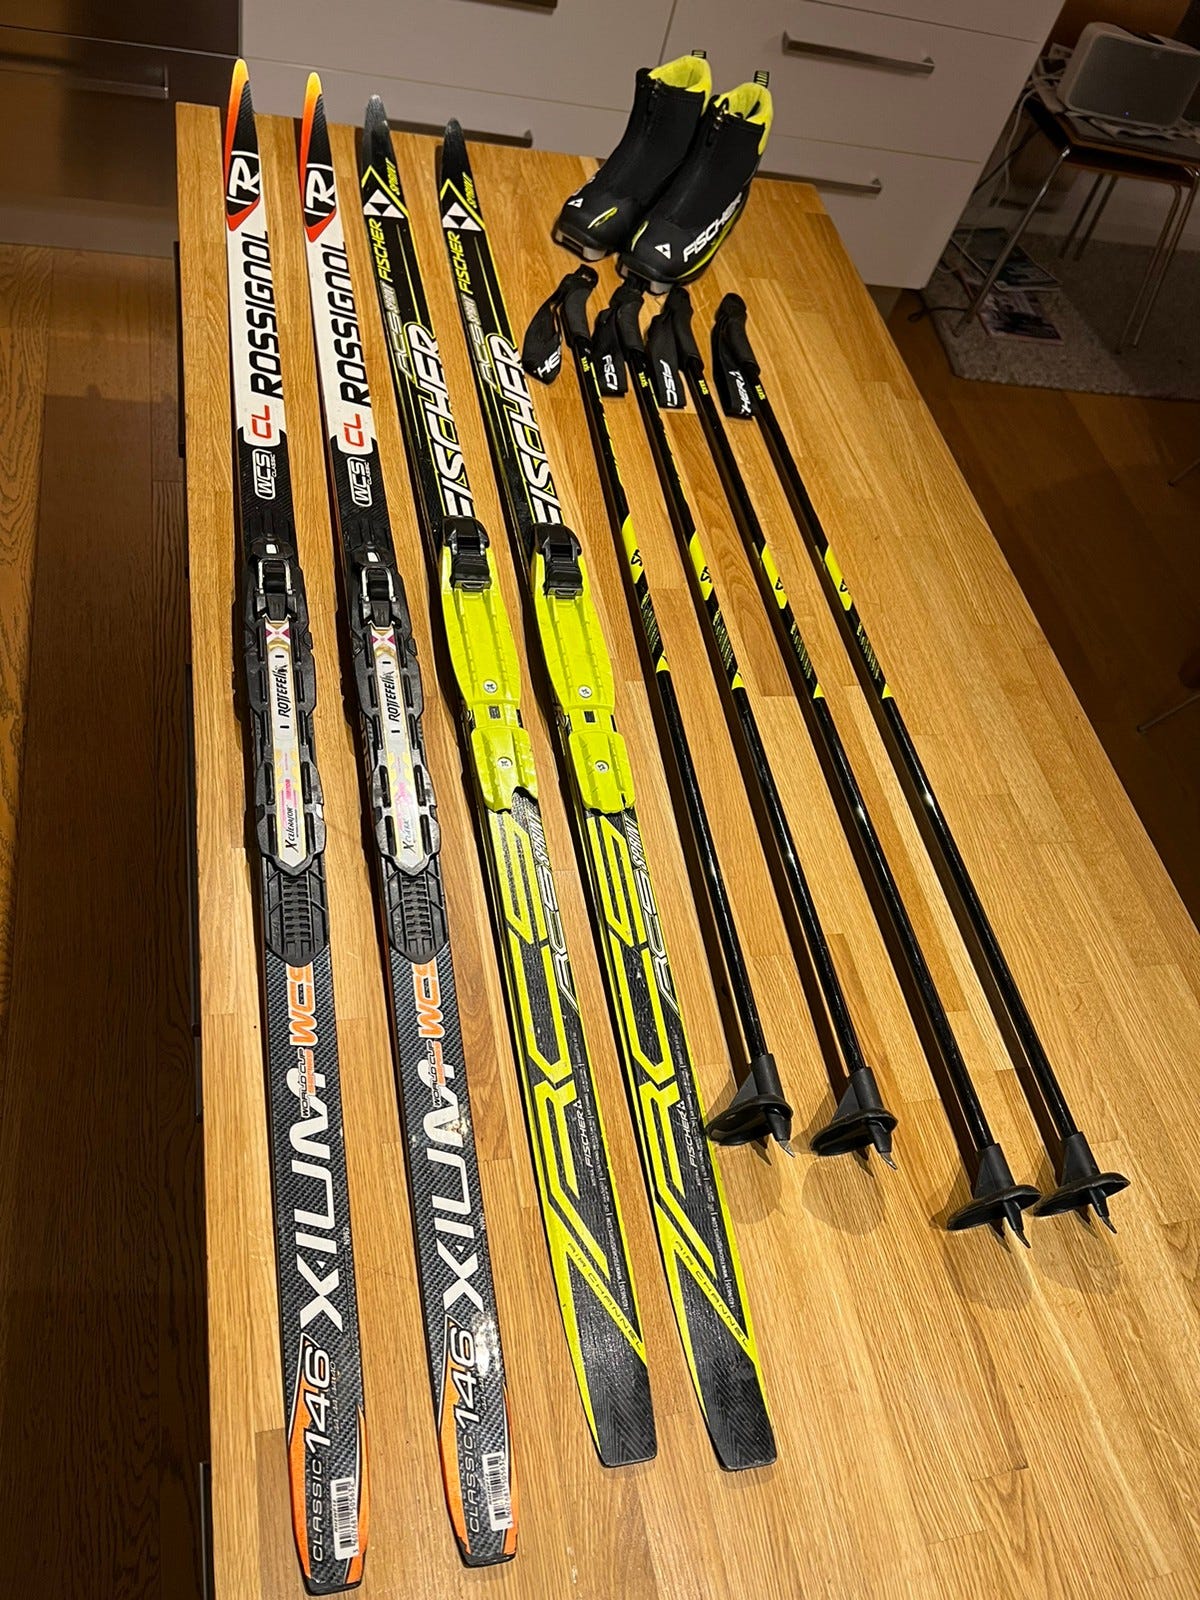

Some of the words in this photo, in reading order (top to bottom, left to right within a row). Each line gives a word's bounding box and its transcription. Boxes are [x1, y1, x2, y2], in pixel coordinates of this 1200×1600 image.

[229, 157, 260, 197] R
[306, 170, 336, 208] R
[368, 217, 394, 283] FISCHER
[447, 231, 474, 295] FISCHER
[241, 230, 284, 400] ROSSIGNOL
[321, 241, 372, 408] ROSSIGNOL
[251, 404, 272, 439] CL
[343, 413, 364, 448] CL
[408, 324, 475, 518] FISCHER
[490, 335, 564, 524] FISCHER
[256, 452, 275, 497] WCS
[350, 460, 371, 504] WCS
[577, 1111, 591, 1167] FISCHER
[681, 1106, 698, 1167] FISCHER
[286, 1067, 343, 1333] XIUM
[417, 1059, 485, 1313] XIUM
[588, 1272, 643, 1352] CHANNEL
[695, 1270, 749, 1348] CHANNEL
[305, 1345, 332, 1454] 146
[450, 1326, 481, 1431] 146
[311, 1458, 326, 1562] CLASSIC
[462, 1434, 480, 1534] CLASSIC
